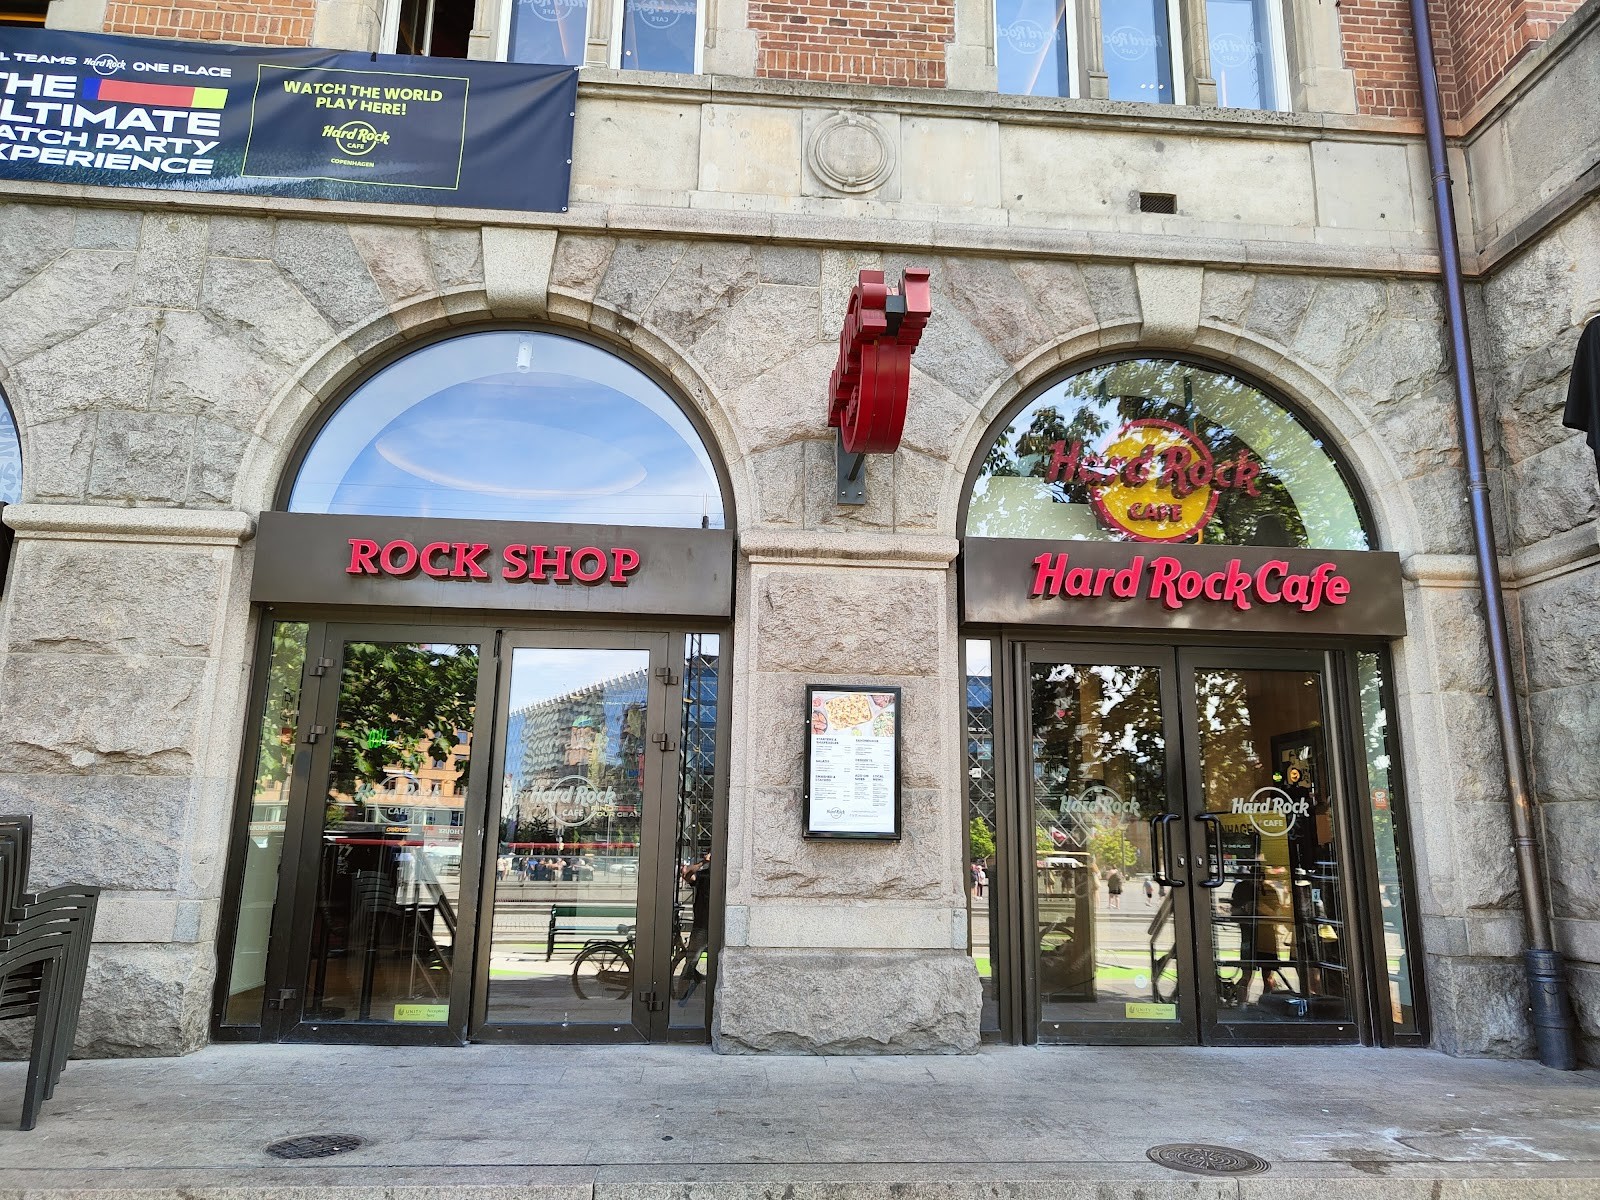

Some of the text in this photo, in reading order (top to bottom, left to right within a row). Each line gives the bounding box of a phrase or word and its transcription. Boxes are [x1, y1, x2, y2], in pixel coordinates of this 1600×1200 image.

[14, 53, 77, 66] TEAMS
[83, 57, 106, 66] Hard
[106, 59, 126, 70] Rock
[132, 61, 169, 72] ONE
[172, 64, 232, 78] PLACE
[283, 80, 443, 102] WATCH THE WORLD
[0, 98, 221, 137] LTIMATE
[315, 97, 407, 116] PLAY HERE!
[0, 124, 220, 155] ATCH PARTY
[321, 124, 390, 145] Hard Rock
[346, 142, 365, 150] CAFE
[0, 143, 214, 175] XPERIENCE
[330, 158, 375, 168] COPENHAGEN
[1044, 438, 1262, 499] Hard Rock
[1127, 502, 1183, 522] CAFE
[345, 538, 640, 583] ROCK SHOP
[1030, 552, 1351, 612] Hard Rock Cafe
[530, 785, 617, 807] Hard Rock
[1060, 796, 1141, 818] Hard Rock
[1231, 797, 1310, 817] Hard Rock
[562, 809, 584, 817] CAFE
